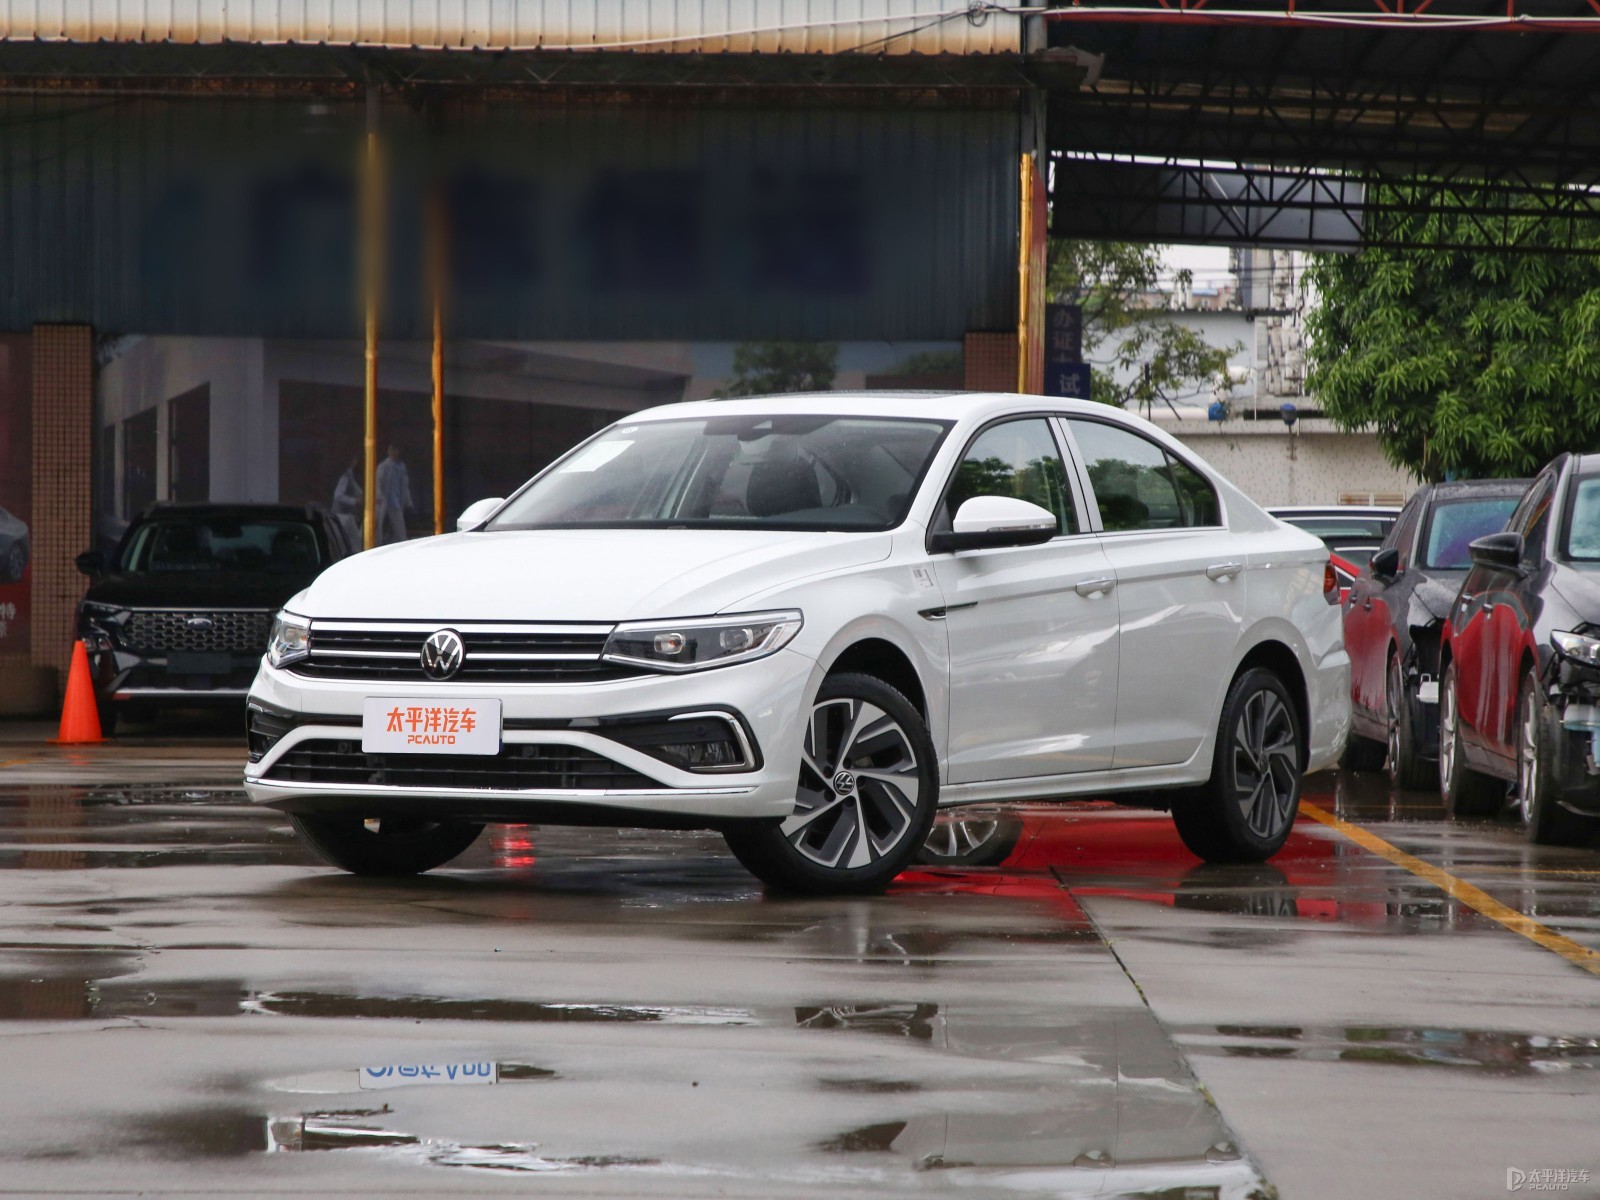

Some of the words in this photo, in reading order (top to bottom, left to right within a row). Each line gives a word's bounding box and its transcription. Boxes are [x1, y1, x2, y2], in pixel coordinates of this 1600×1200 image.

[386, 706, 477, 733] 太平洋汽车
[407, 734, 456, 745] PCAUTO
